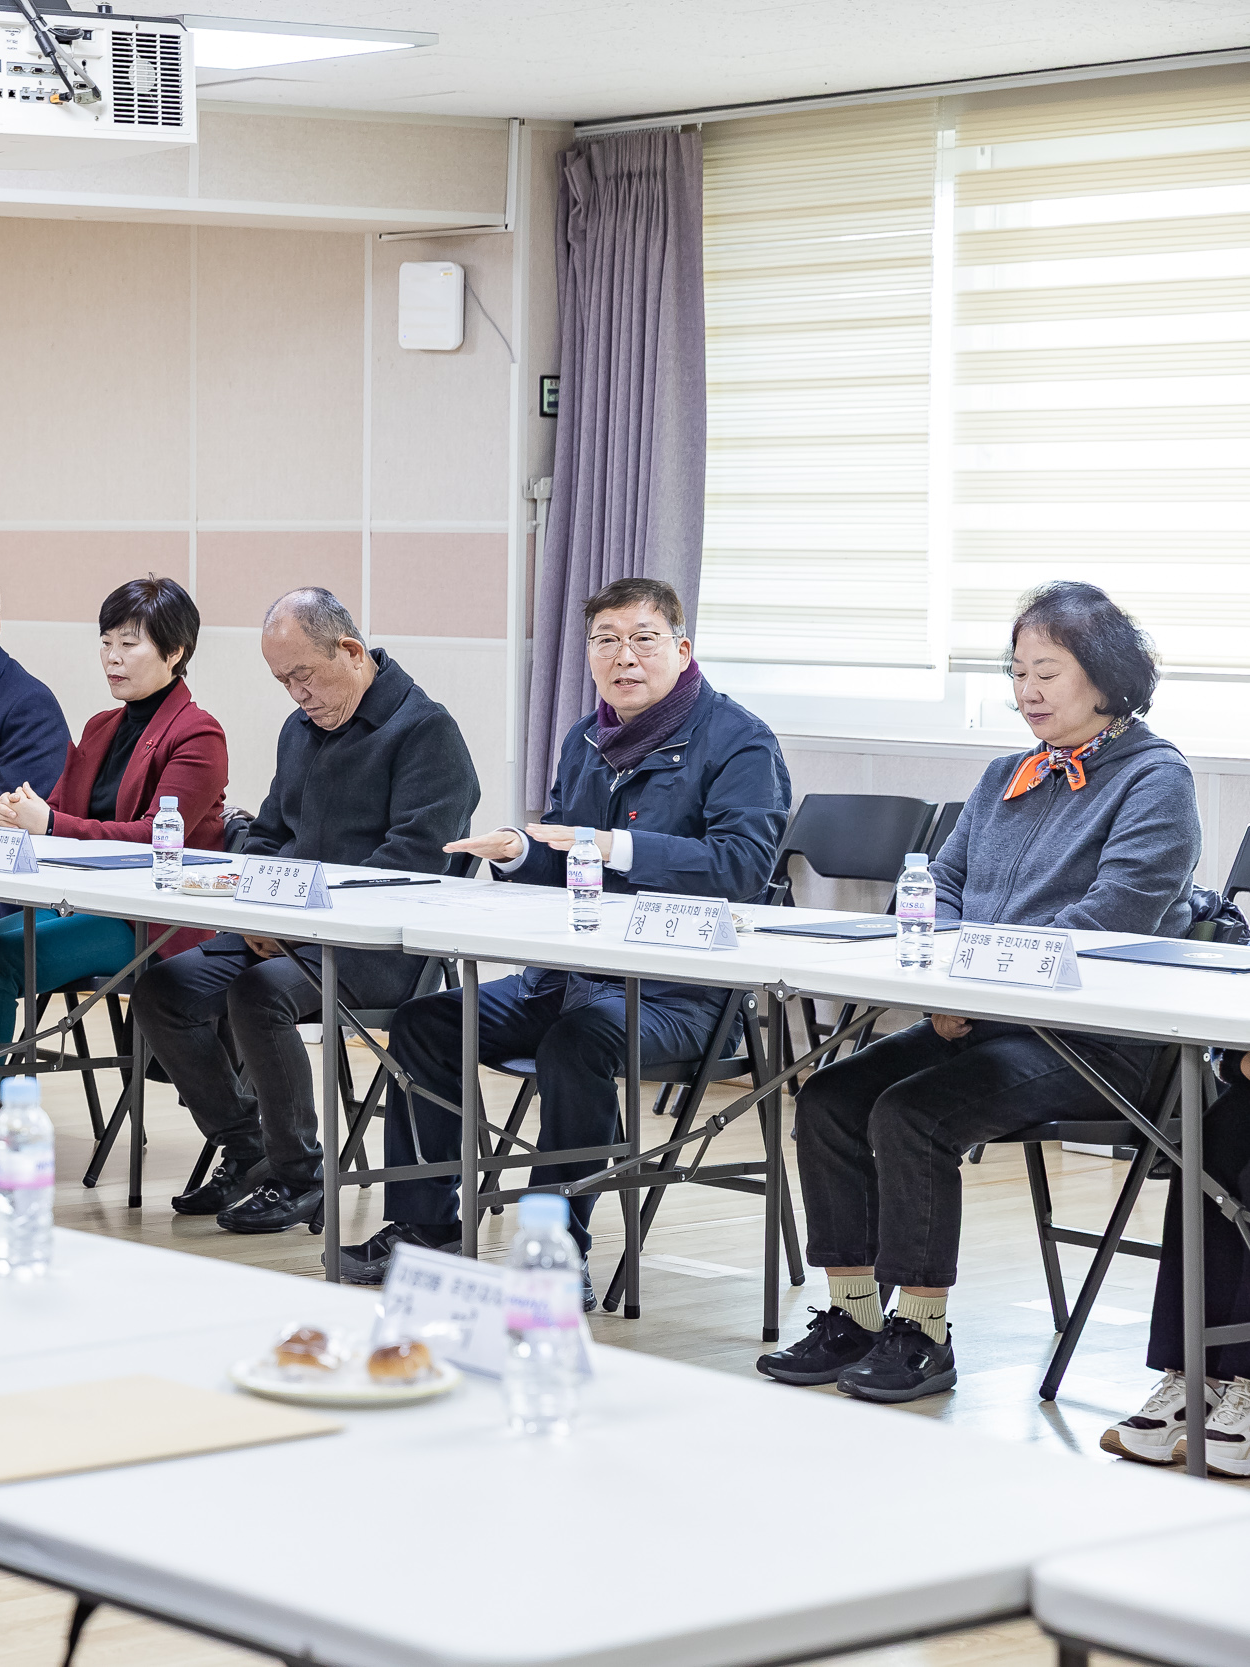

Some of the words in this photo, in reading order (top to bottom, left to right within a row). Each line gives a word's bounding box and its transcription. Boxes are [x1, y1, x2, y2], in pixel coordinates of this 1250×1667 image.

[11, 836, 21, 846] 위원
[258, 864, 300, 878] 광진구청장
[240, 875, 254, 893] 김
[267, 878, 281, 897] 경
[294, 882, 308, 897] 호
[636, 901, 662, 912] 자양3동
[664, 903, 701, 916] 주민자치회
[704, 906, 720, 918] 위원
[631, 914, 647, 935] 정
[665, 917, 679, 938] 인
[697, 920, 713, 941] 숙
[962, 932, 992, 946] 자양3동
[996, 935, 1040, 950] 주민자치회
[1044, 940, 1063, 953] 위원
[956, 947, 974, 970] 채
[996, 952, 1014, 972] 금
[1037, 955, 1056, 979] 희
